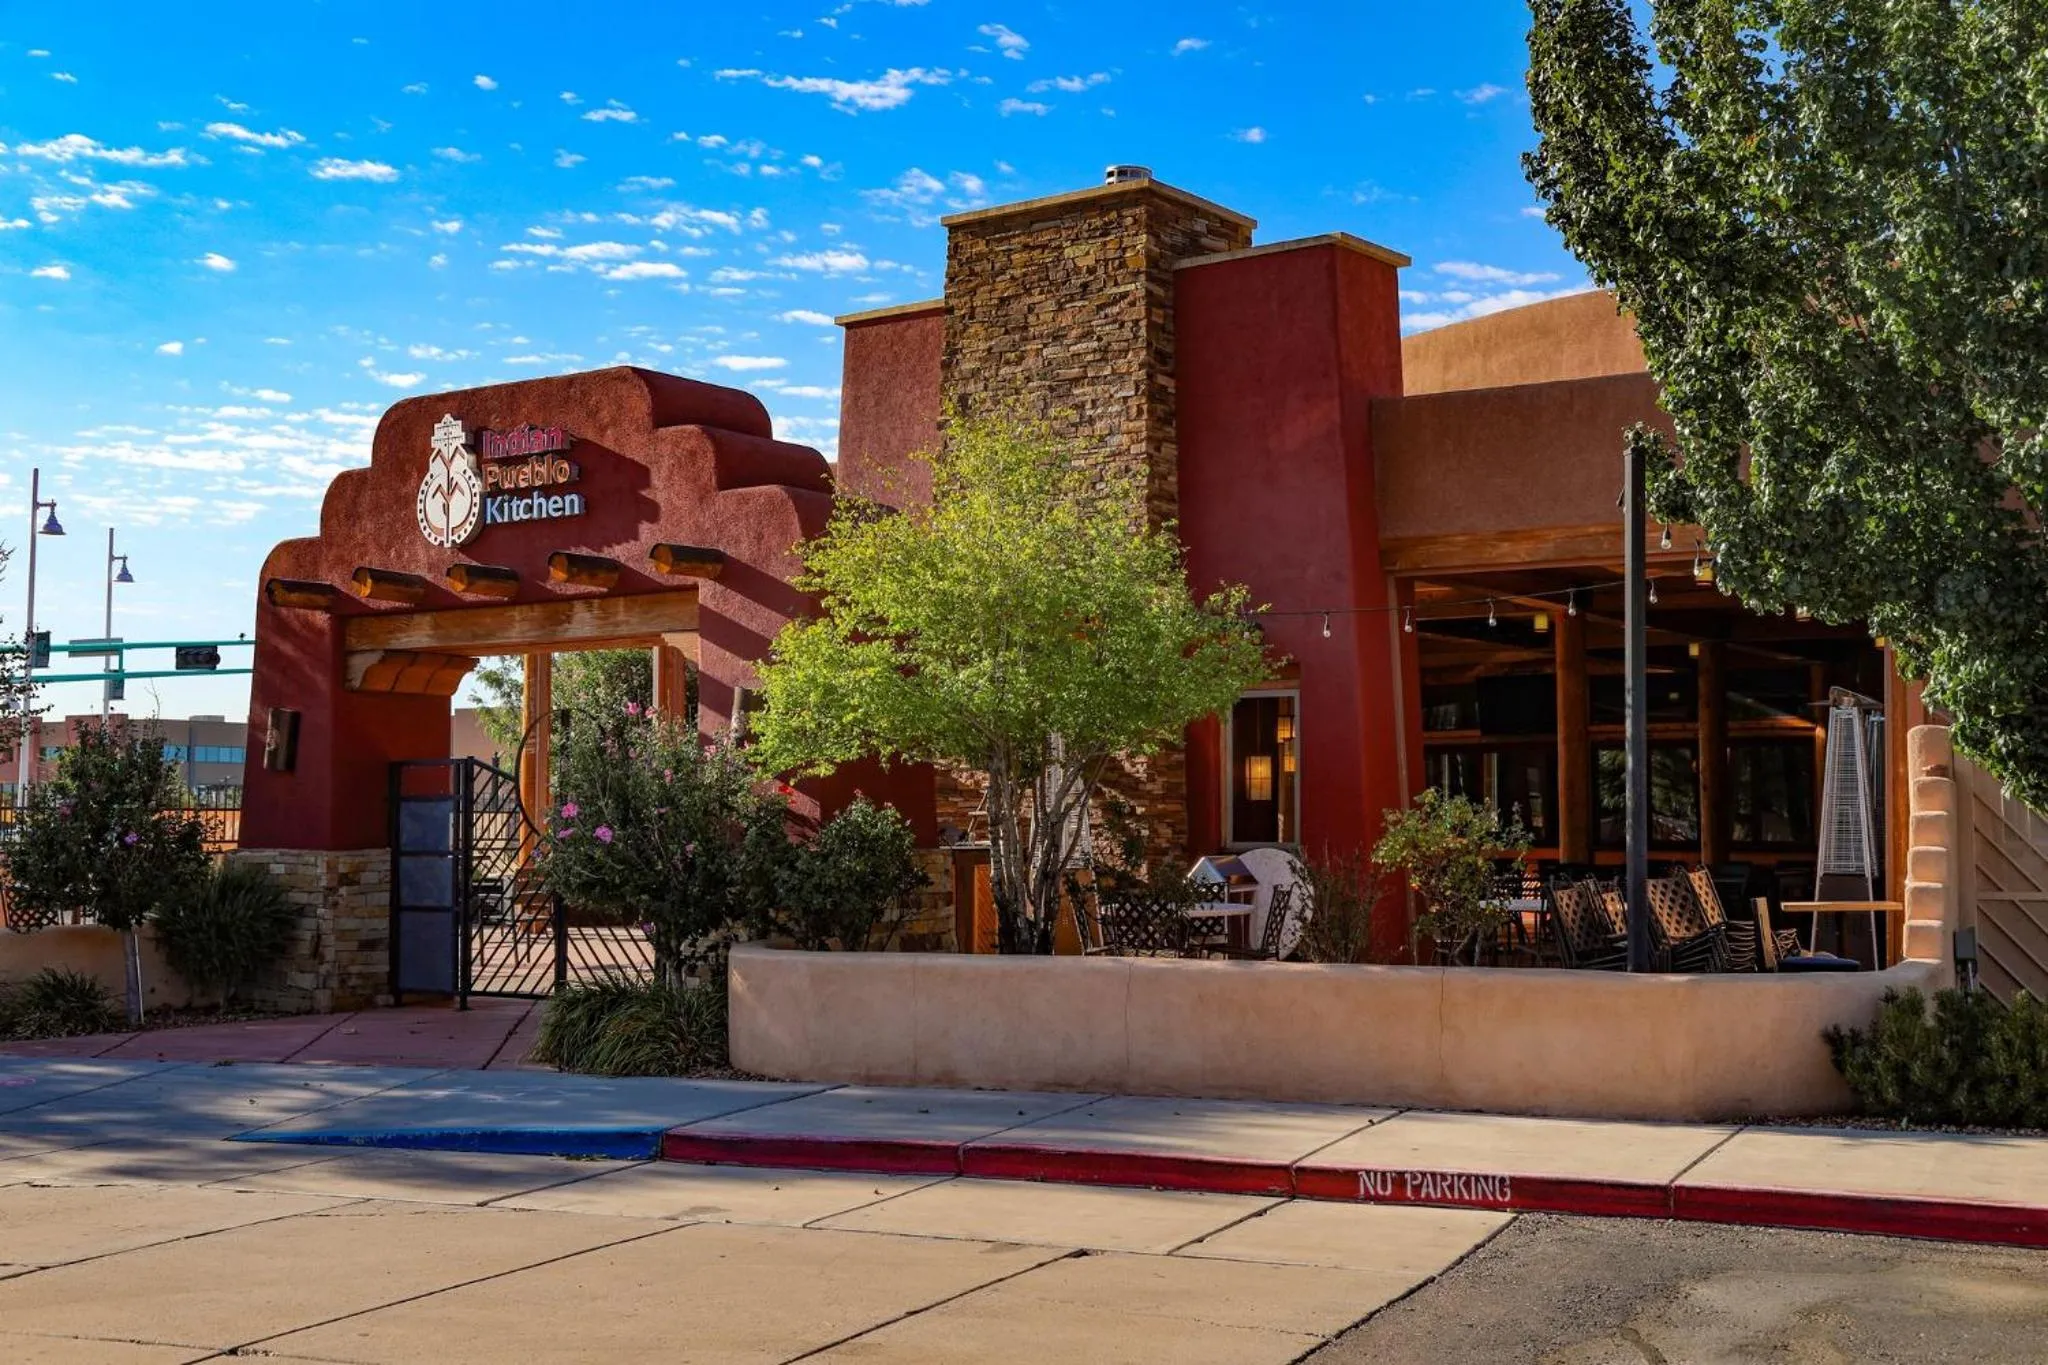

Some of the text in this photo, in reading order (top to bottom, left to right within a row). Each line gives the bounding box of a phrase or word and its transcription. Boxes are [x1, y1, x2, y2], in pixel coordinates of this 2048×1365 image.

[482, 423, 565, 458] Indian
[482, 456, 571, 491] Pueblo
[485, 491, 581, 524] Kitchen
[1358, 1171, 1512, 1202] NO PARKING
